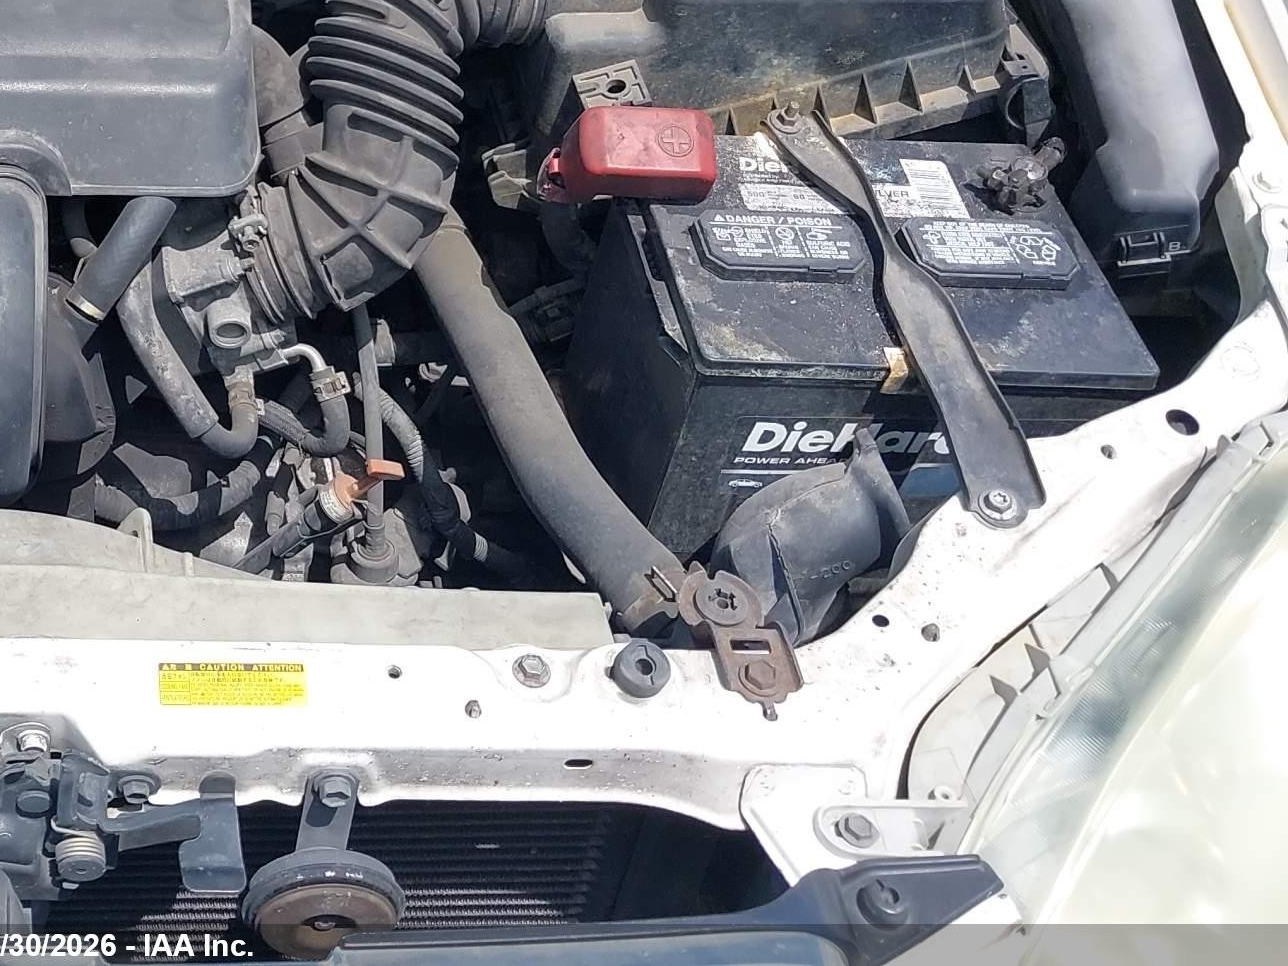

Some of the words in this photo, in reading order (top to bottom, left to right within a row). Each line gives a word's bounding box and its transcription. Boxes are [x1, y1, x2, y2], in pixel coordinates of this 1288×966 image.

[874, 189, 909, 198] ILVER
[725, 214, 776, 225] DANGER
[787, 216, 832, 226] POISON
[733, 457, 791, 465] POWER
[199, 663, 245, 671] CAUTION
[252, 664, 303, 672] ATTENTION
